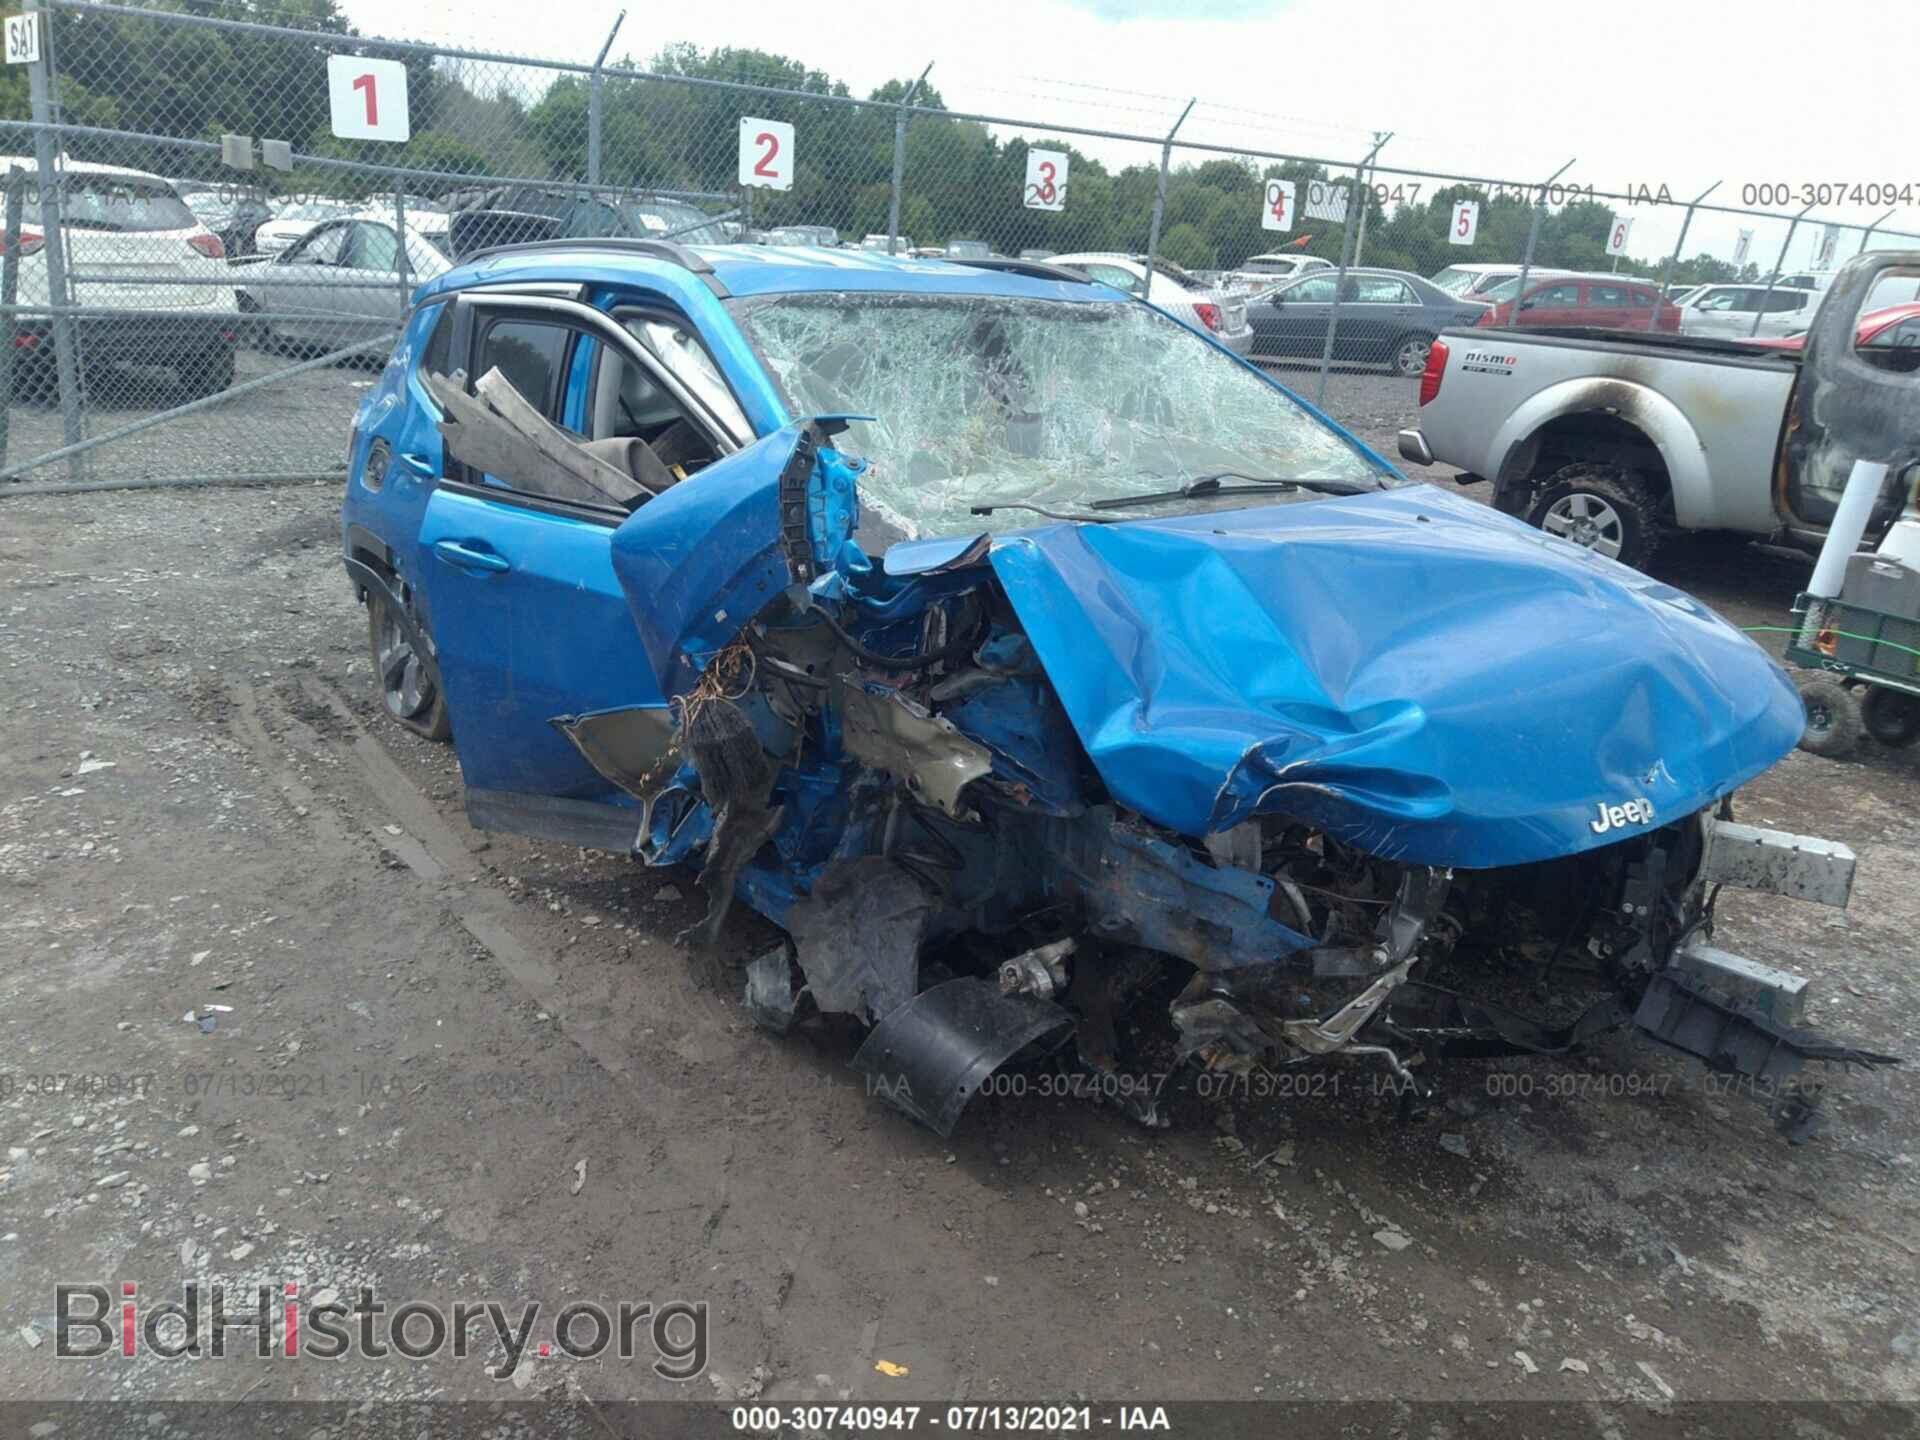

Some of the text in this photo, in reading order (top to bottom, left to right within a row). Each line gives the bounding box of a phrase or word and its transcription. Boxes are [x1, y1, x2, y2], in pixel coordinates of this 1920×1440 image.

[353, 74, 378, 126] 1
[754, 132, 779, 177] 2
[1039, 161, 1056, 200] 3
[1271, 190, 1285, 222] 4
[1457, 208, 1471, 237] 5
[1612, 223, 1625, 249] 6
[1589, 797, 1654, 834] Jeep
